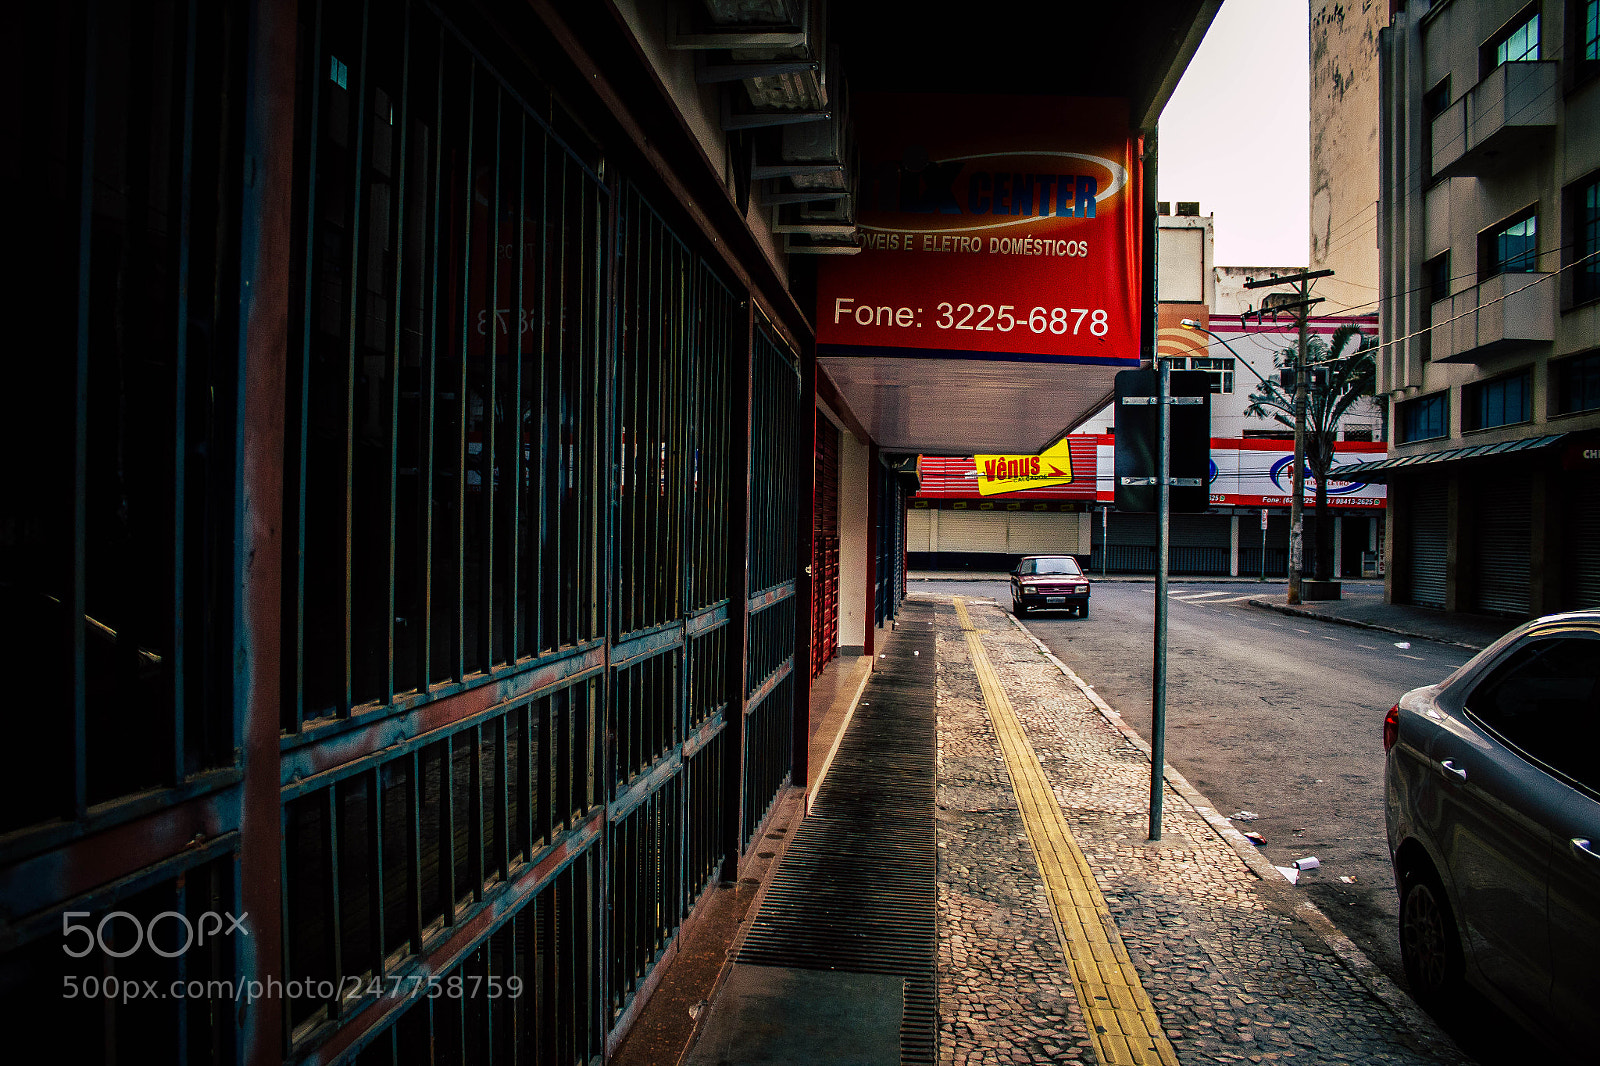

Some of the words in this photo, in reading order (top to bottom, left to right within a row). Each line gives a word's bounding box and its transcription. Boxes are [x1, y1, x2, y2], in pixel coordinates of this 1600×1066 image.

[968, 171, 1098, 218] CENTER
[856, 229, 900, 251] ÓVEIS
[904, 235, 913, 250] E
[923, 235, 982, 253] ELETRO
[989, 235, 1088, 257] DOMÉSTICOS
[834, 298, 922, 327] Fone:
[936, 302, 1109, 337] 3225-6878
[985, 456, 1040, 482] Vênus
